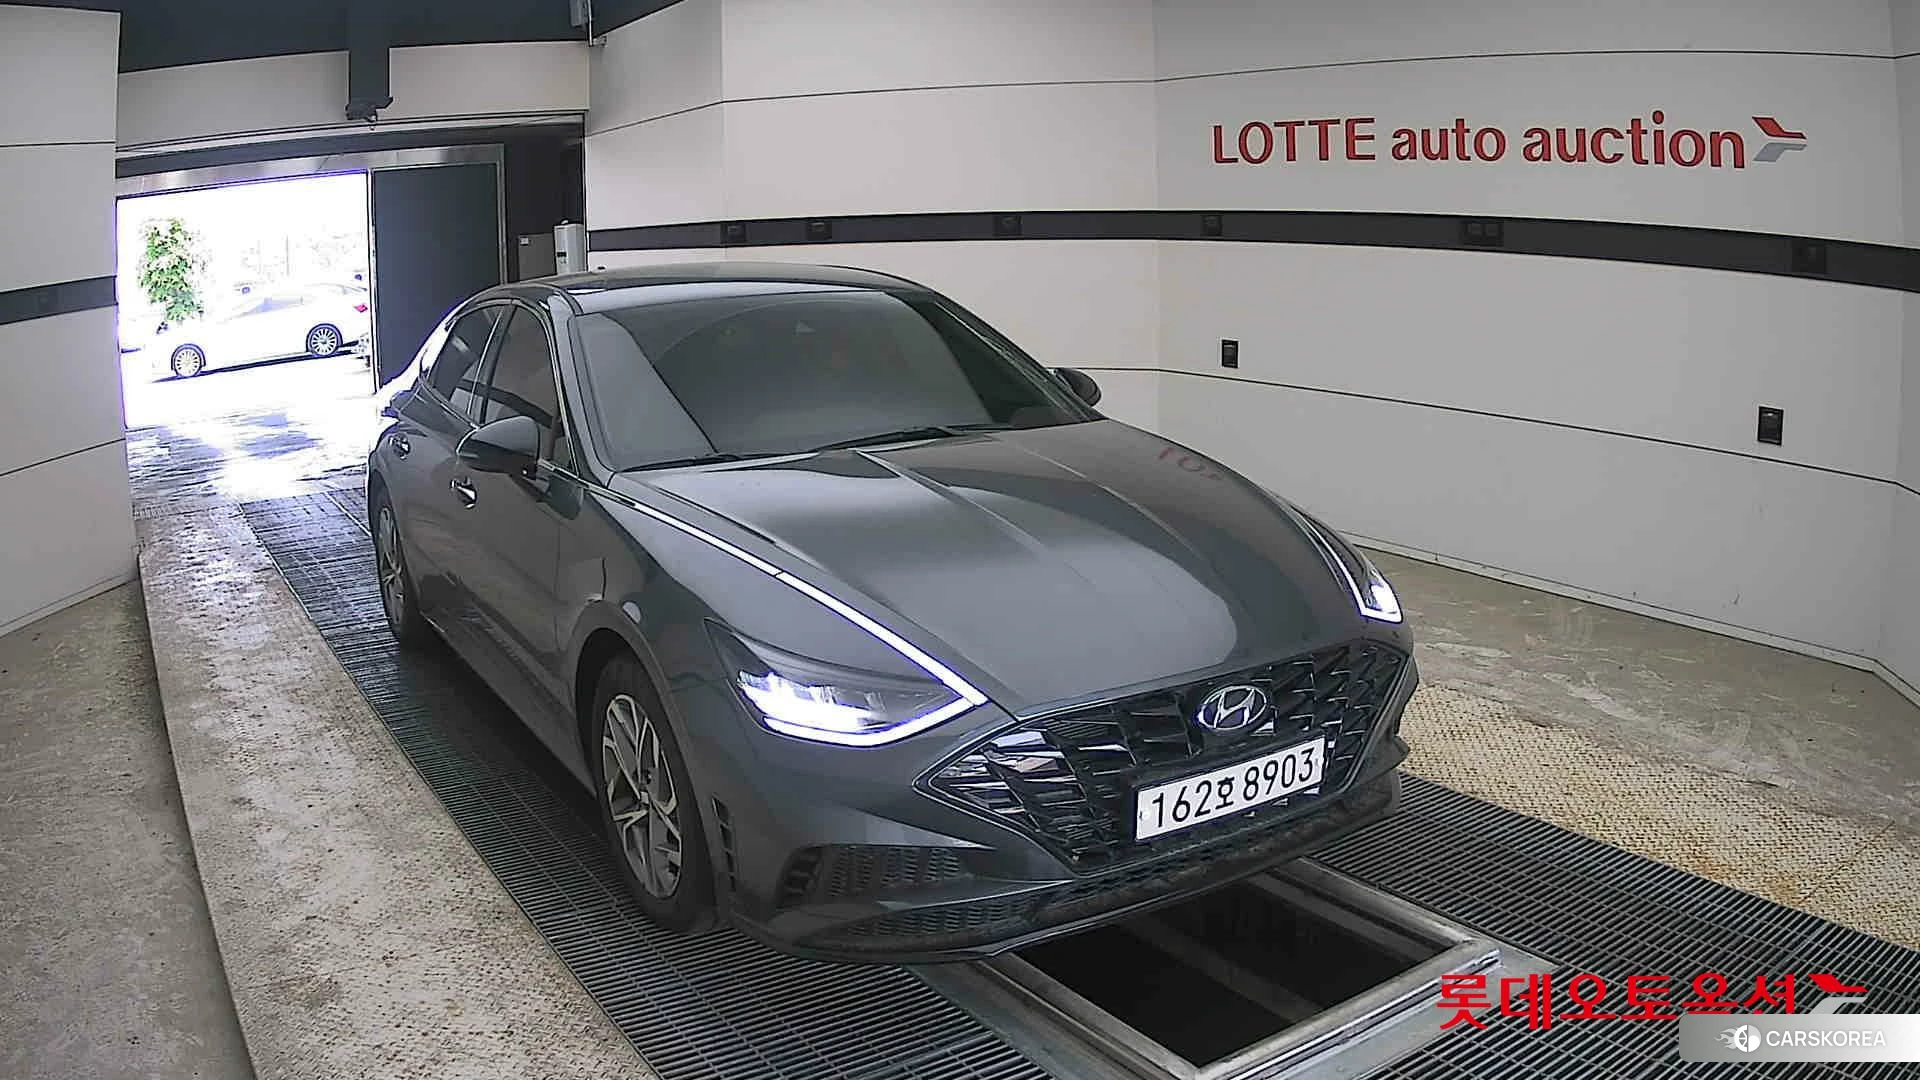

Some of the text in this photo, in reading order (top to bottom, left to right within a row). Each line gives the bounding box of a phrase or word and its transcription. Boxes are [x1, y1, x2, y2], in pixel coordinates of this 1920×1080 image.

[1213, 110, 1746, 169] LOTTE auto auction
